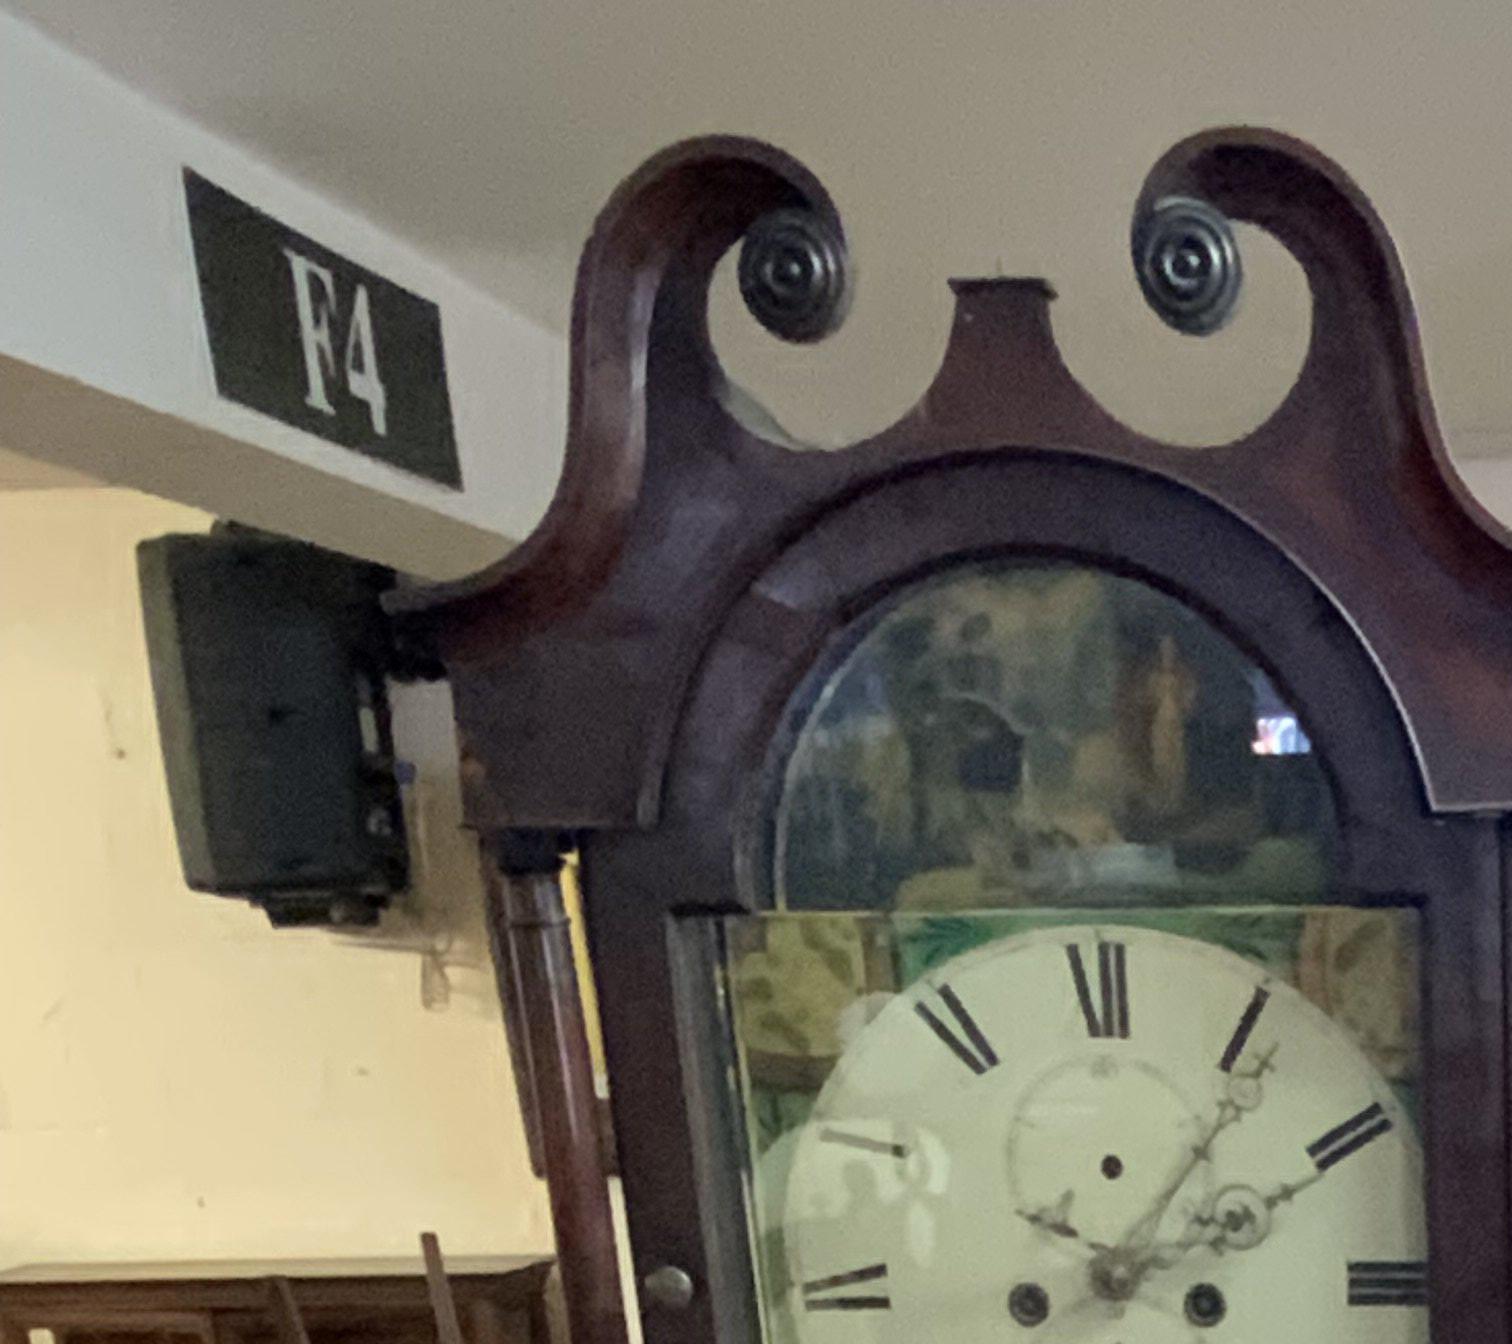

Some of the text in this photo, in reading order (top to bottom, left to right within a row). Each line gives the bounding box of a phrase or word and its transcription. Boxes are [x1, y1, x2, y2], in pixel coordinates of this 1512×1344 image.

[282, 246, 387, 437] F4
[1305, 1102, 1393, 1172] II
[1347, 1261, 1429, 1306] III
